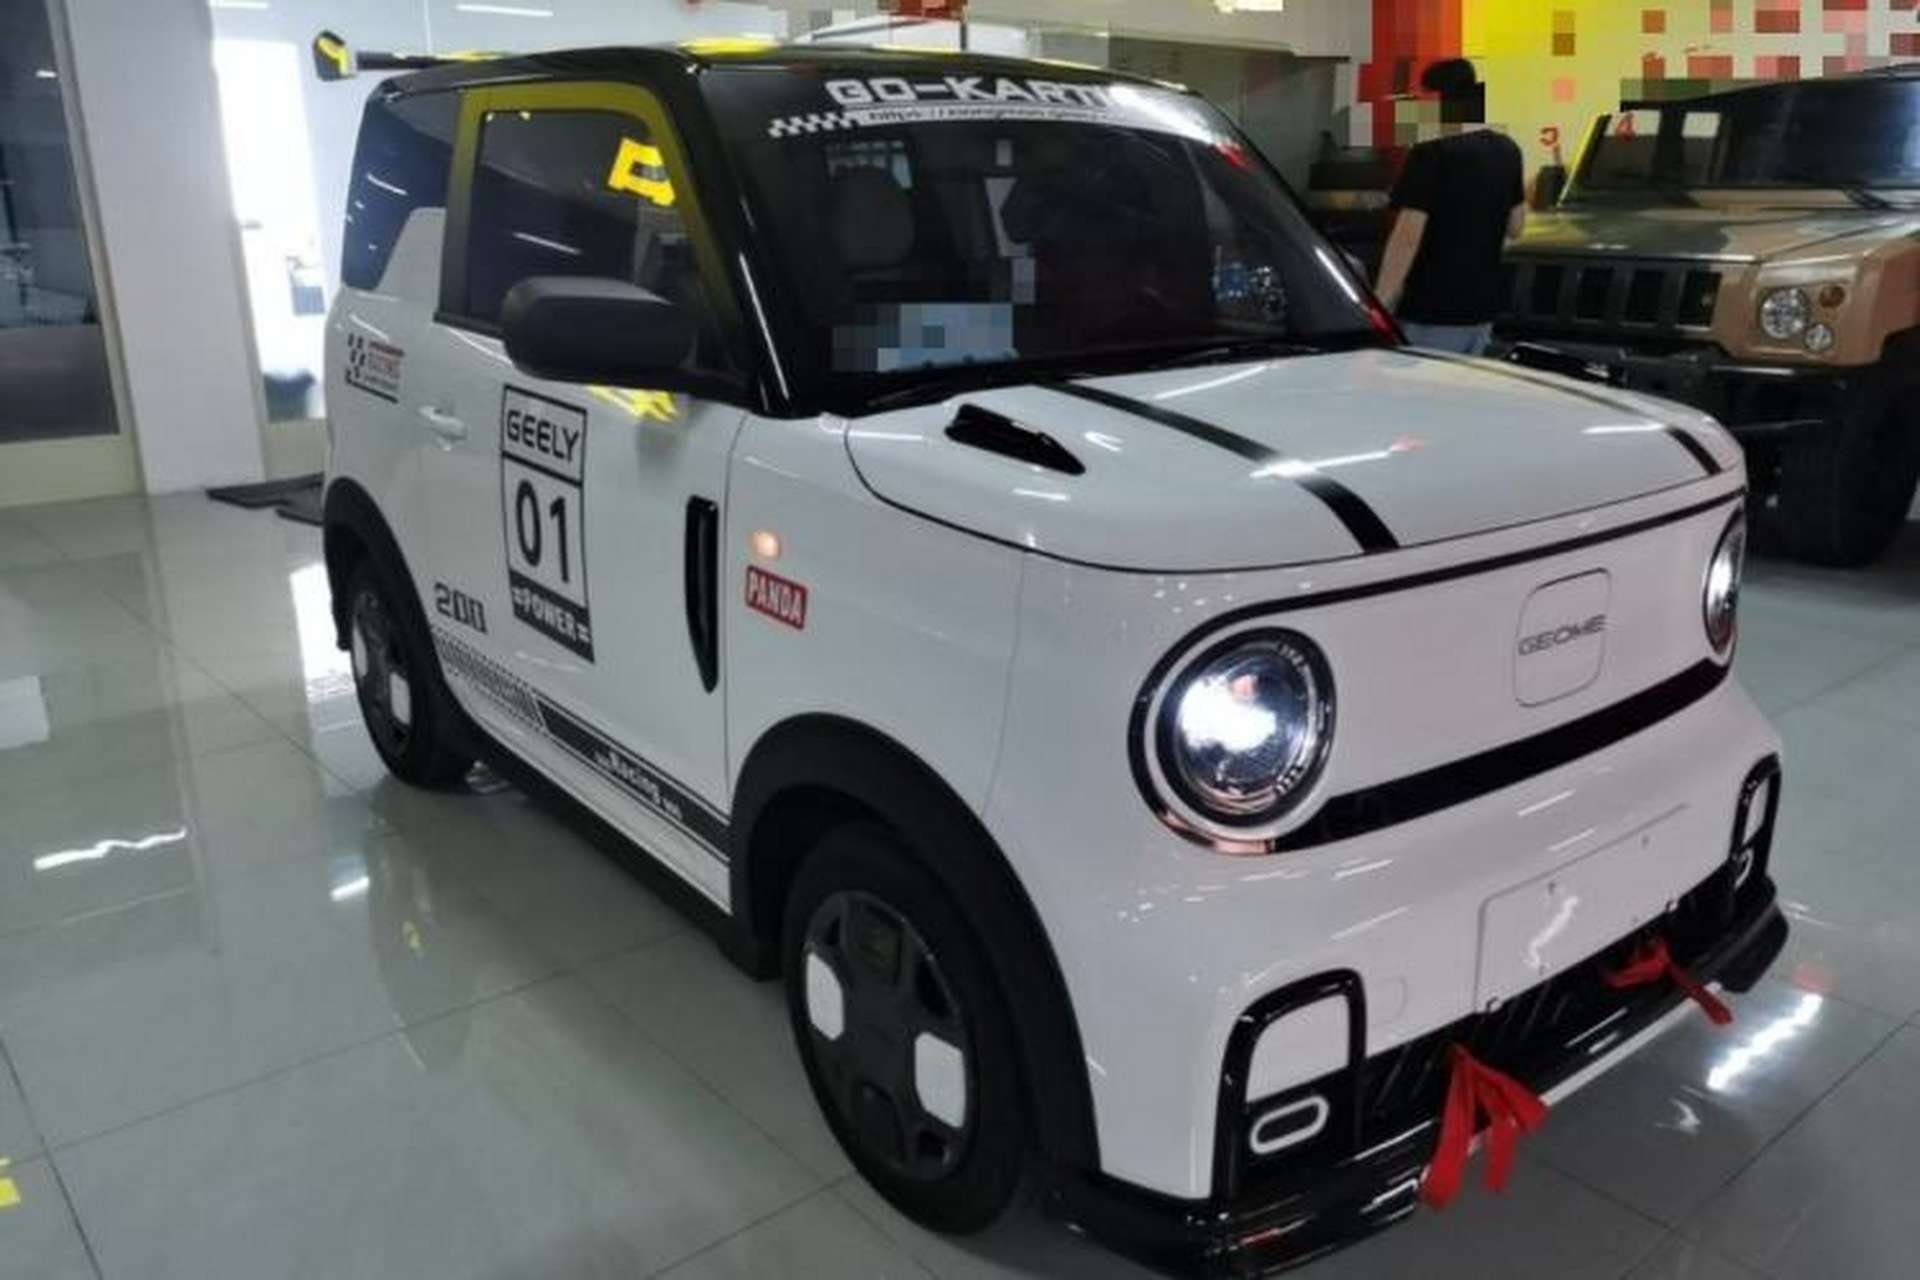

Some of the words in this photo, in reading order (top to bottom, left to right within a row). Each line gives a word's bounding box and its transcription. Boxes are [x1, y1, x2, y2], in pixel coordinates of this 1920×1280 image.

[506, 409, 579, 463] GEELY
[516, 478, 569, 584] 01
[434, 581, 487, 635] 200
[749, 570, 802, 625] PANDA
